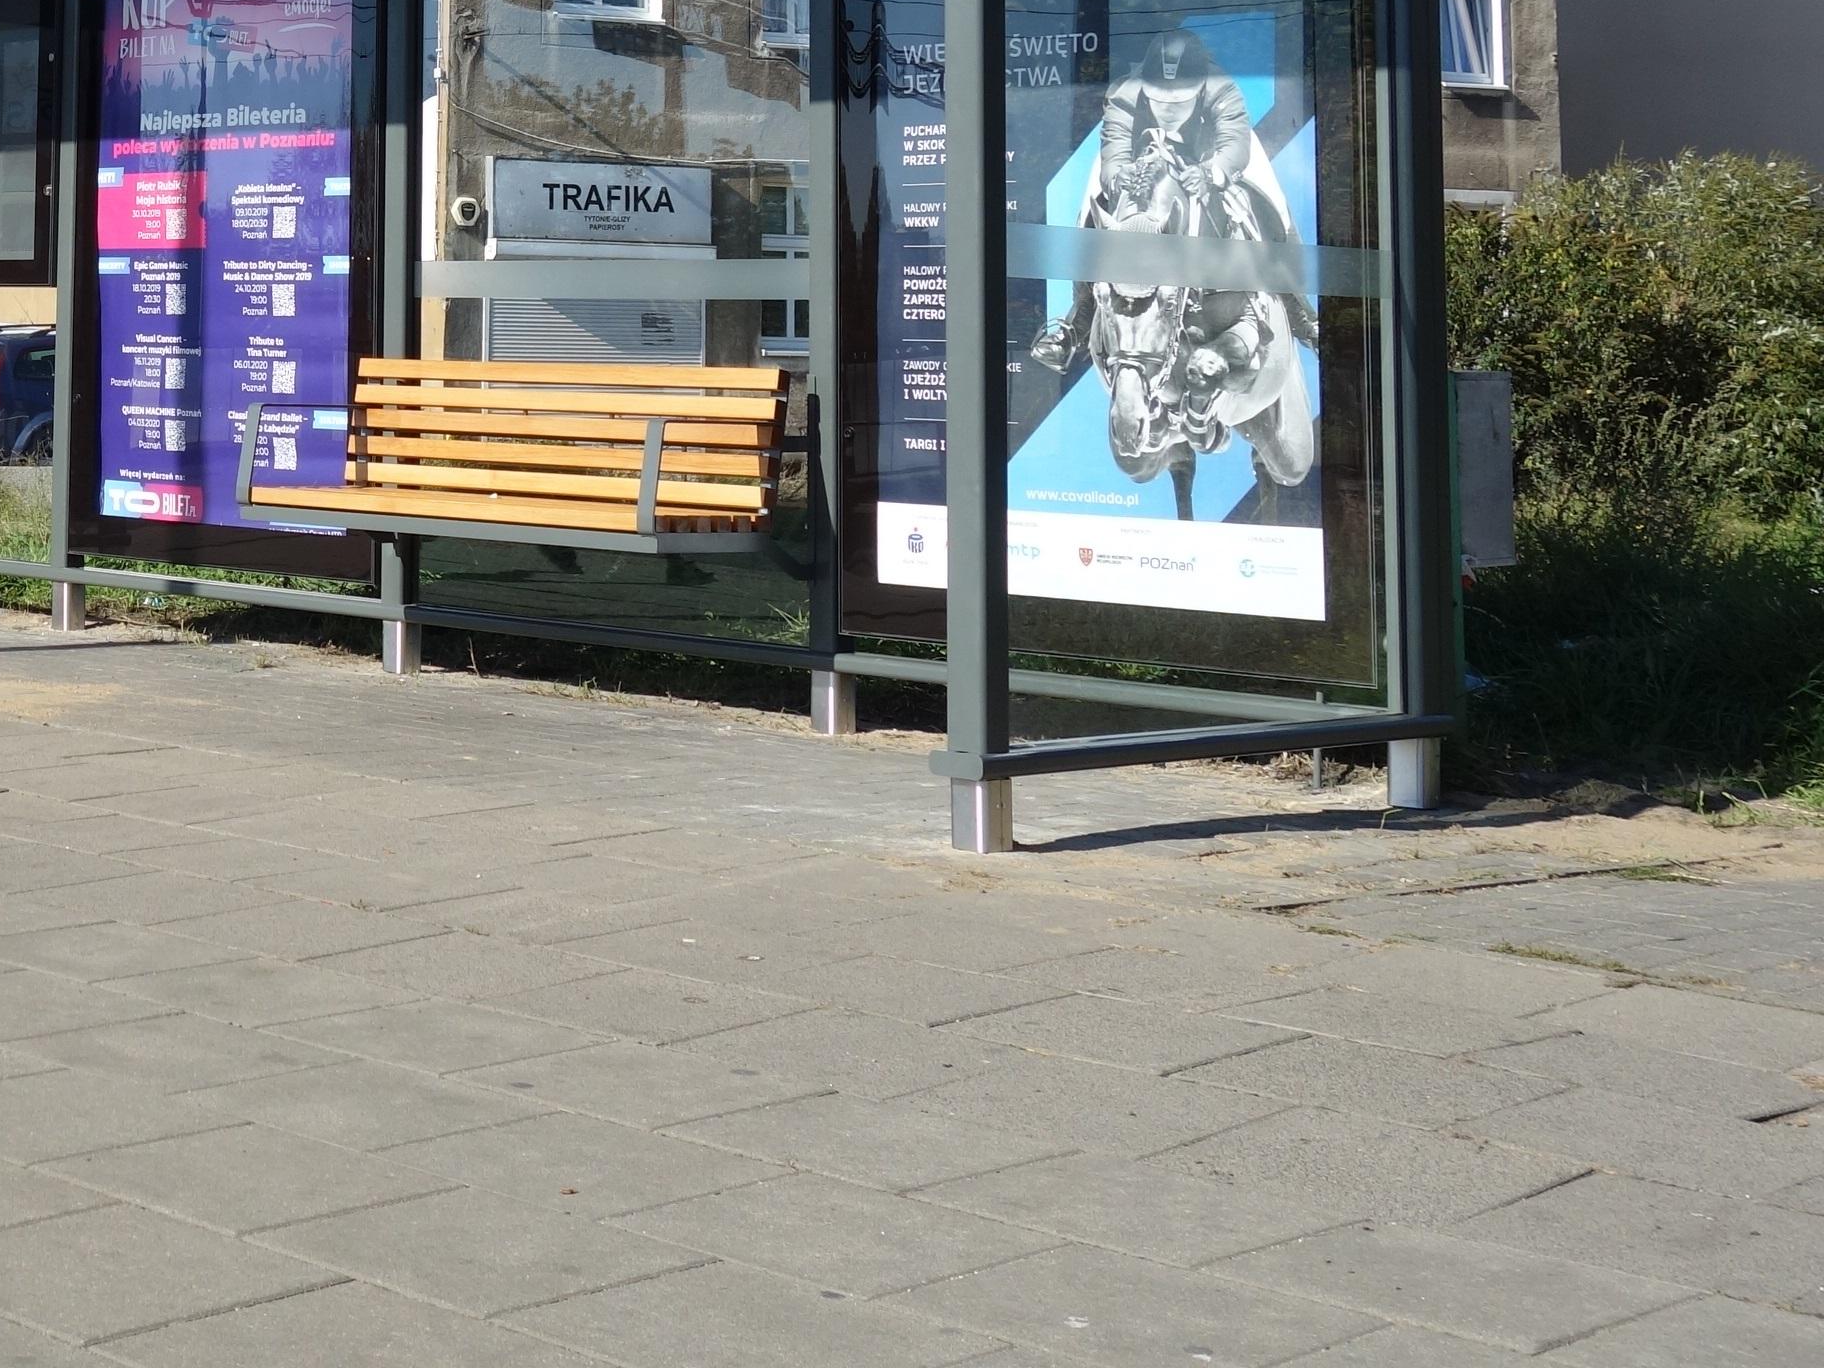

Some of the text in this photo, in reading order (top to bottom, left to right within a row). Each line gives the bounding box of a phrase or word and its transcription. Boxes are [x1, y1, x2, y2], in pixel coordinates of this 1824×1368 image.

[120, 34, 175, 59] BILET NA
[903, 32, 1098, 64] WIE ŚWIĘTO
[140, 102, 306, 134] Najlepsza Bileteria
[903, 124, 946, 137] PUCHAR
[113, 138, 157, 159] poleca
[243, 136, 257, 149] w
[259, 129, 335, 148] Poznaniu:
[903, 139, 945, 151] W SKOK
[902, 154, 937, 166] PRZEZ
[157, 180, 181, 191] Rubik
[136, 193, 187, 207] Moja historia
[263, 194, 304, 204] komediowy
[542, 182, 675, 213] TRAFIKA
[903, 203, 941, 213] HALOWY
[903, 216, 939, 228] WKKW
[137, 231, 161, 240] Poznań
[242, 231, 267, 240] Poznań
[134, 261, 188, 271] Epic Game Music
[223, 260, 249, 270] Tribute
[249, 260, 257, 270] to
[258, 261, 277, 271] Dirty
[277, 260, 307, 271] Dancing
[903, 265, 941, 276] HALOWY
[140, 272, 181, 281] Poznań 2019
[223, 272, 244, 281] Music
[250, 272, 273, 281] Dance
[274, 273, 295, 281] Show
[295, 273, 312, 281] 2019
[903, 277, 946, 290] POWOŻE
[903, 293, 945, 307] ZAPRZĘ
[137, 305, 161, 314] Poznań
[242, 306, 268, 315] Poznań
[903, 308, 945, 320] CZTERO
[136, 334, 156, 343] Visual
[157, 334, 182, 343] Concert
[248, 336, 284, 346] Tribute to
[121, 344, 202, 356] koncert muzyki filmowej
[246, 347, 287, 358] Tina Turner
[902, 360, 941, 371] ZAWODY
[903, 372, 946, 386] UJEŻDŻ
[241, 383, 267, 392] Poznań
[903, 389, 947, 401] I WOLTY
[121, 405, 202, 418] QUEEN MACHINE Poznań
[281, 413, 303, 423] Ballet
[138, 440, 162, 450] Poznań
[903, 437, 937, 450] TARGI
[119, 468, 142, 479] Więcej
[142, 471, 174, 481] wydarzeń
[1025, 489, 1139, 507] www.cavaliada.pl
